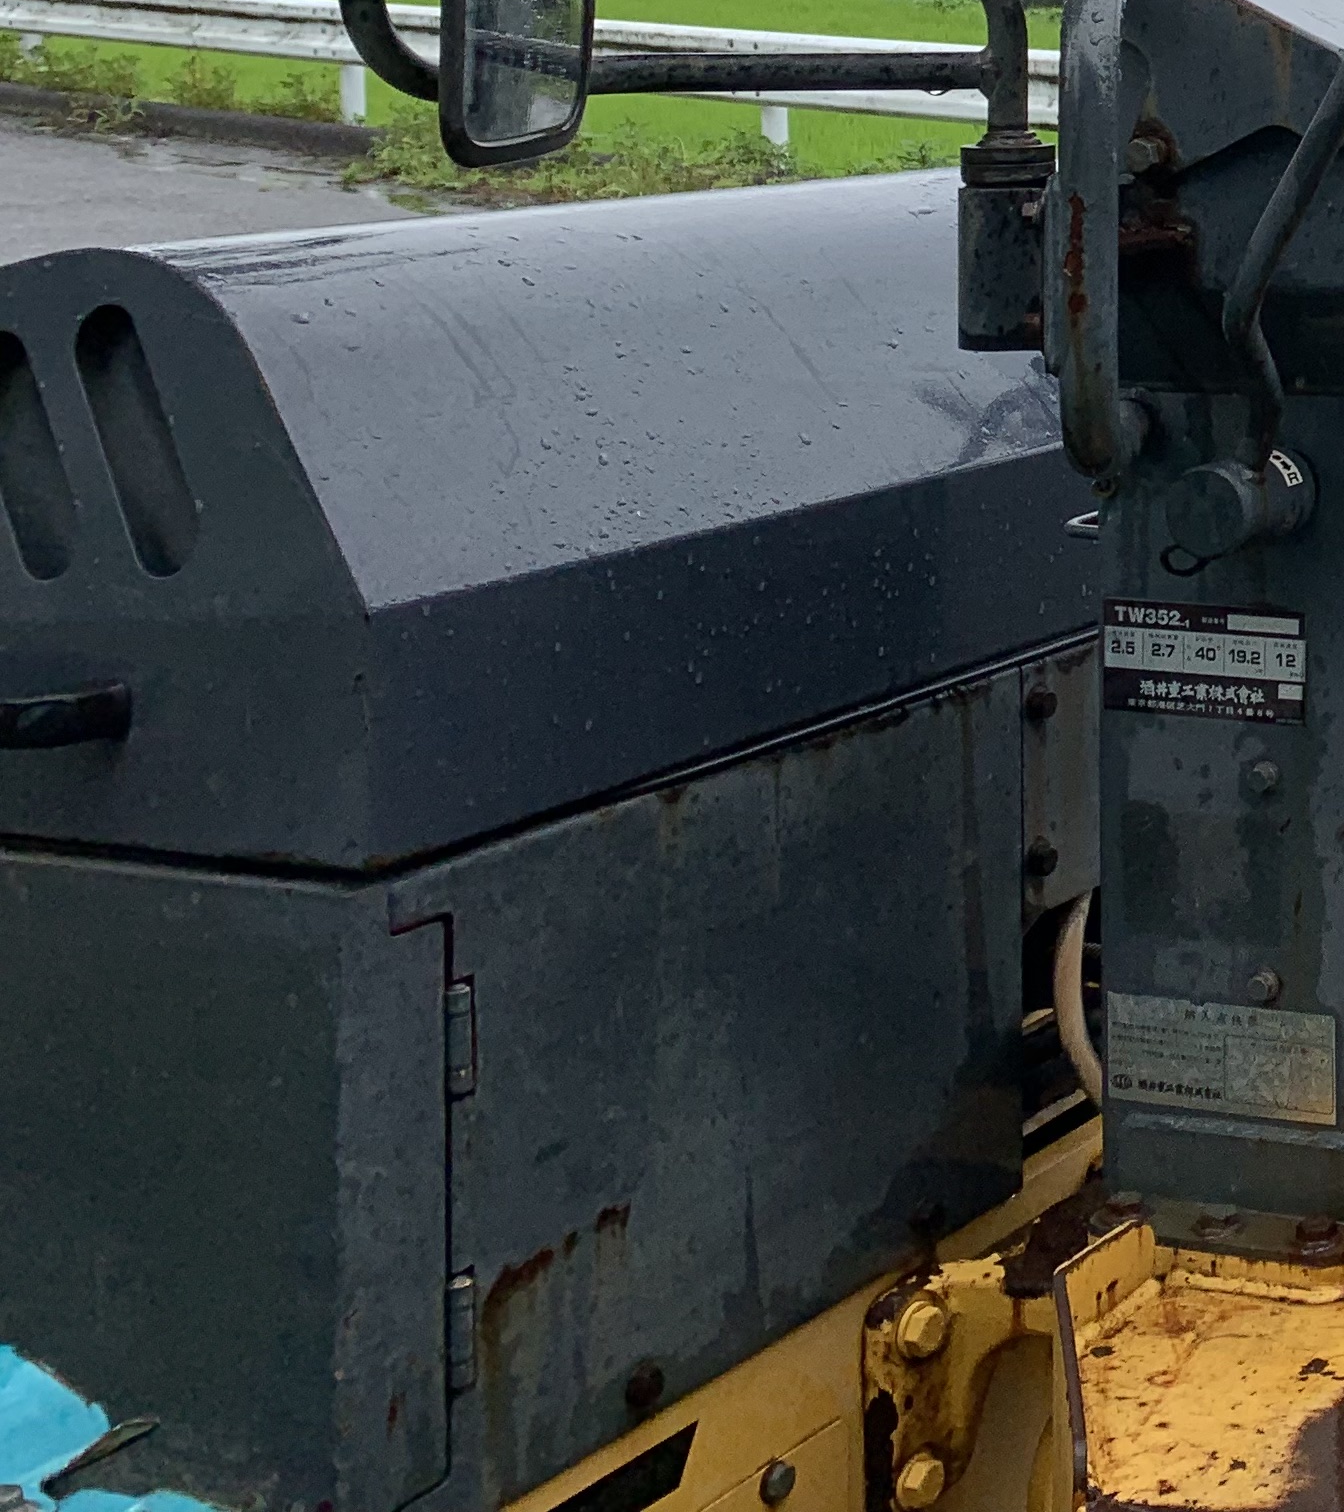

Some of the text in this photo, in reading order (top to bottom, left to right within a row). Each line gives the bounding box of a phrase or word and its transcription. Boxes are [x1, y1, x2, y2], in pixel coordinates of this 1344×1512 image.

[1111, 640, 1135, 655] 2.5
[1151, 643, 1175, 658] 2.7
[1228, 649, 1261, 665] 19.2
[1276, 653, 1296, 668] 12
